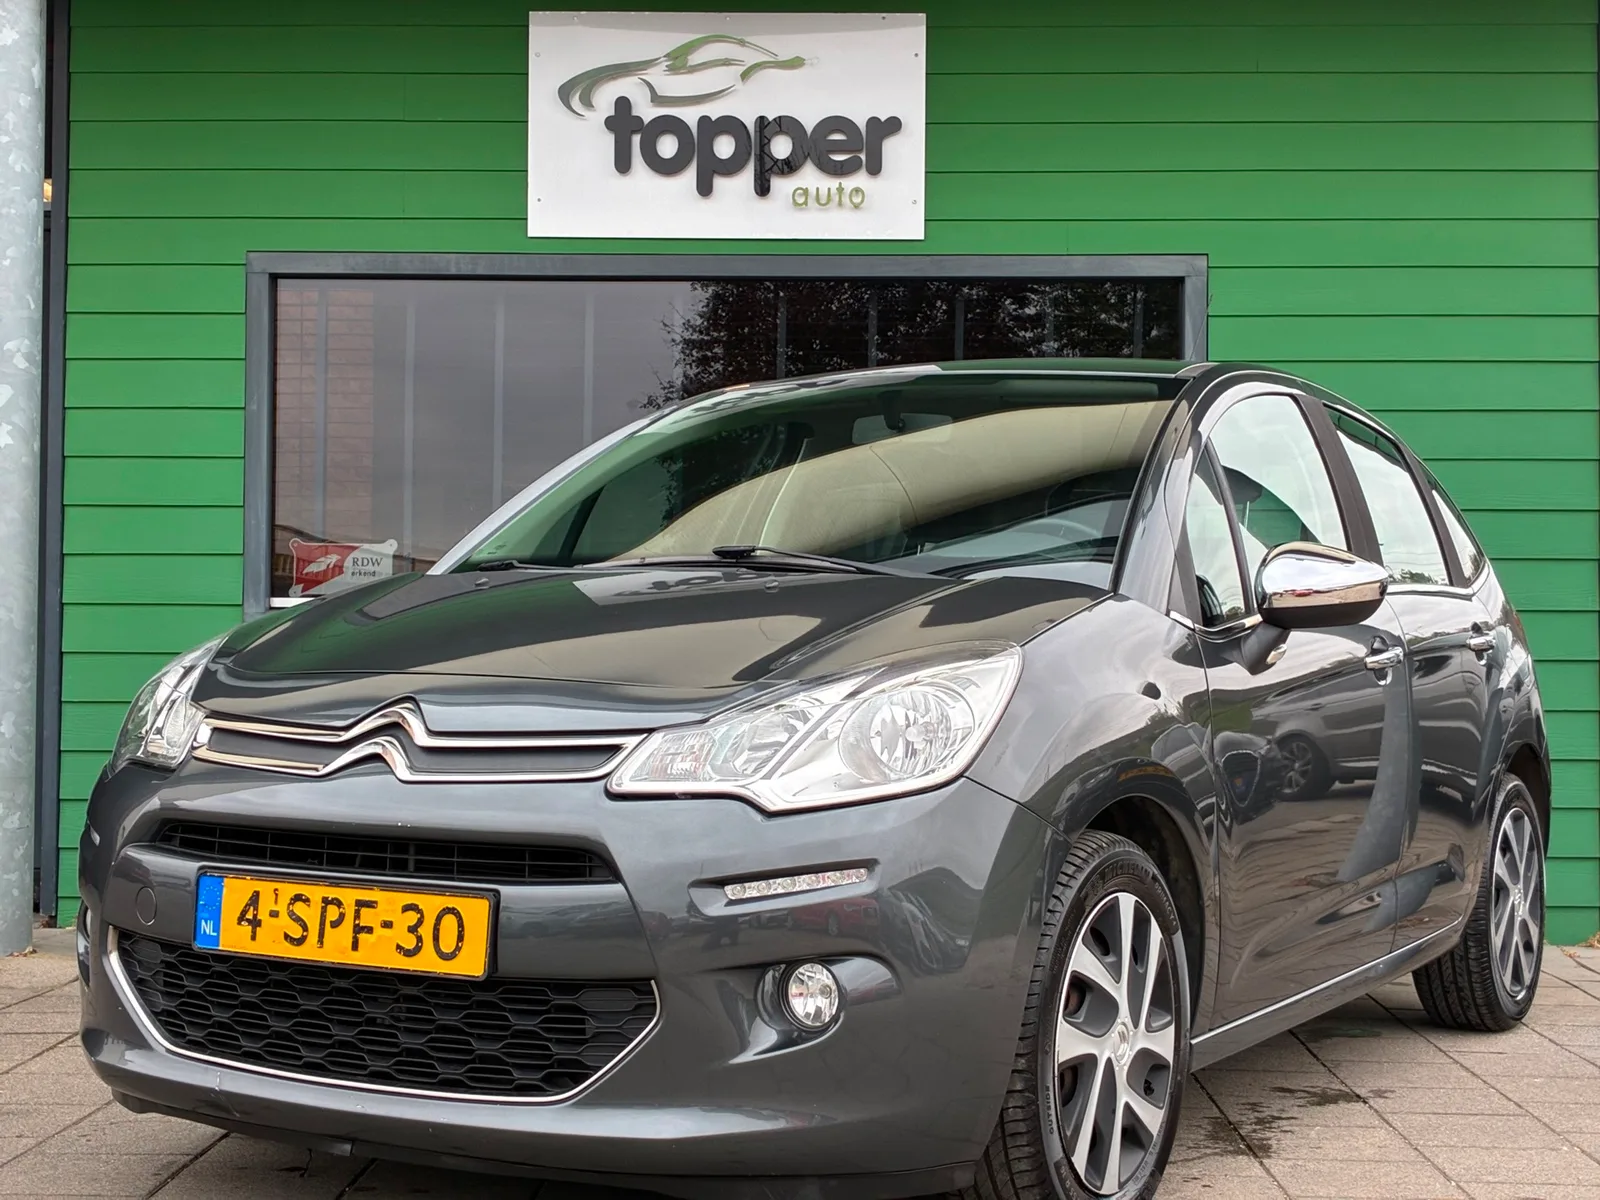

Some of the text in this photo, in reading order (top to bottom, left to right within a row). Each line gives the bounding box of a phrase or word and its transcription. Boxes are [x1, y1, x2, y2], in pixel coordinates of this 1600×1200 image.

[604, 96, 902, 197] topper
[791, 181, 866, 209] auto
[351, 569, 376, 578] erkend
[352, 557, 383, 567] RDW
[200, 918, 218, 936] NL
[236, 890, 465, 960] 4-SPF-30
[1045, 1084, 1055, 1135] OUTSIDE
